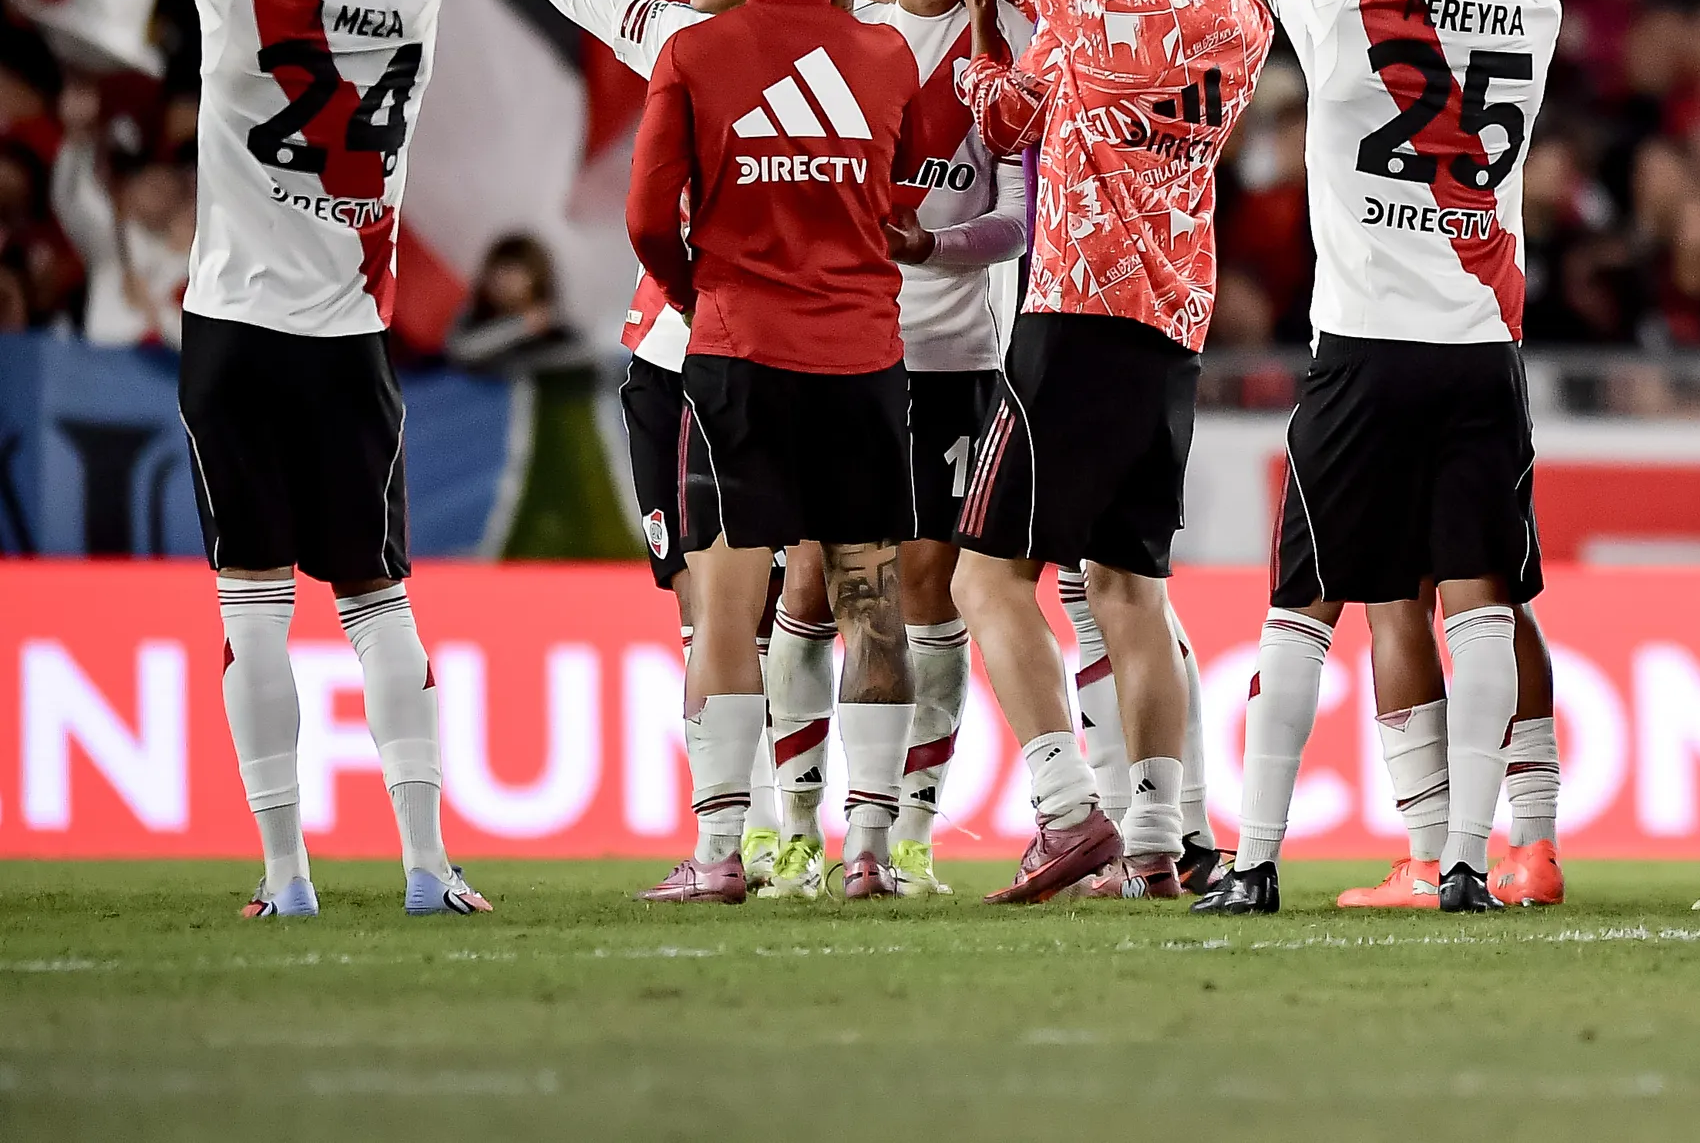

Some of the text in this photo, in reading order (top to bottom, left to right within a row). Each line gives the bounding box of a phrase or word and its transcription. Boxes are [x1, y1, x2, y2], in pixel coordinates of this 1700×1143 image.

[333, 5, 404, 38] MEZA
[247, 38, 422, 178] 24
[1355, 39, 1533, 191] 25
[735, 156, 868, 185] DIRECTV
[1361, 196, 1494, 240] DIRECTV
